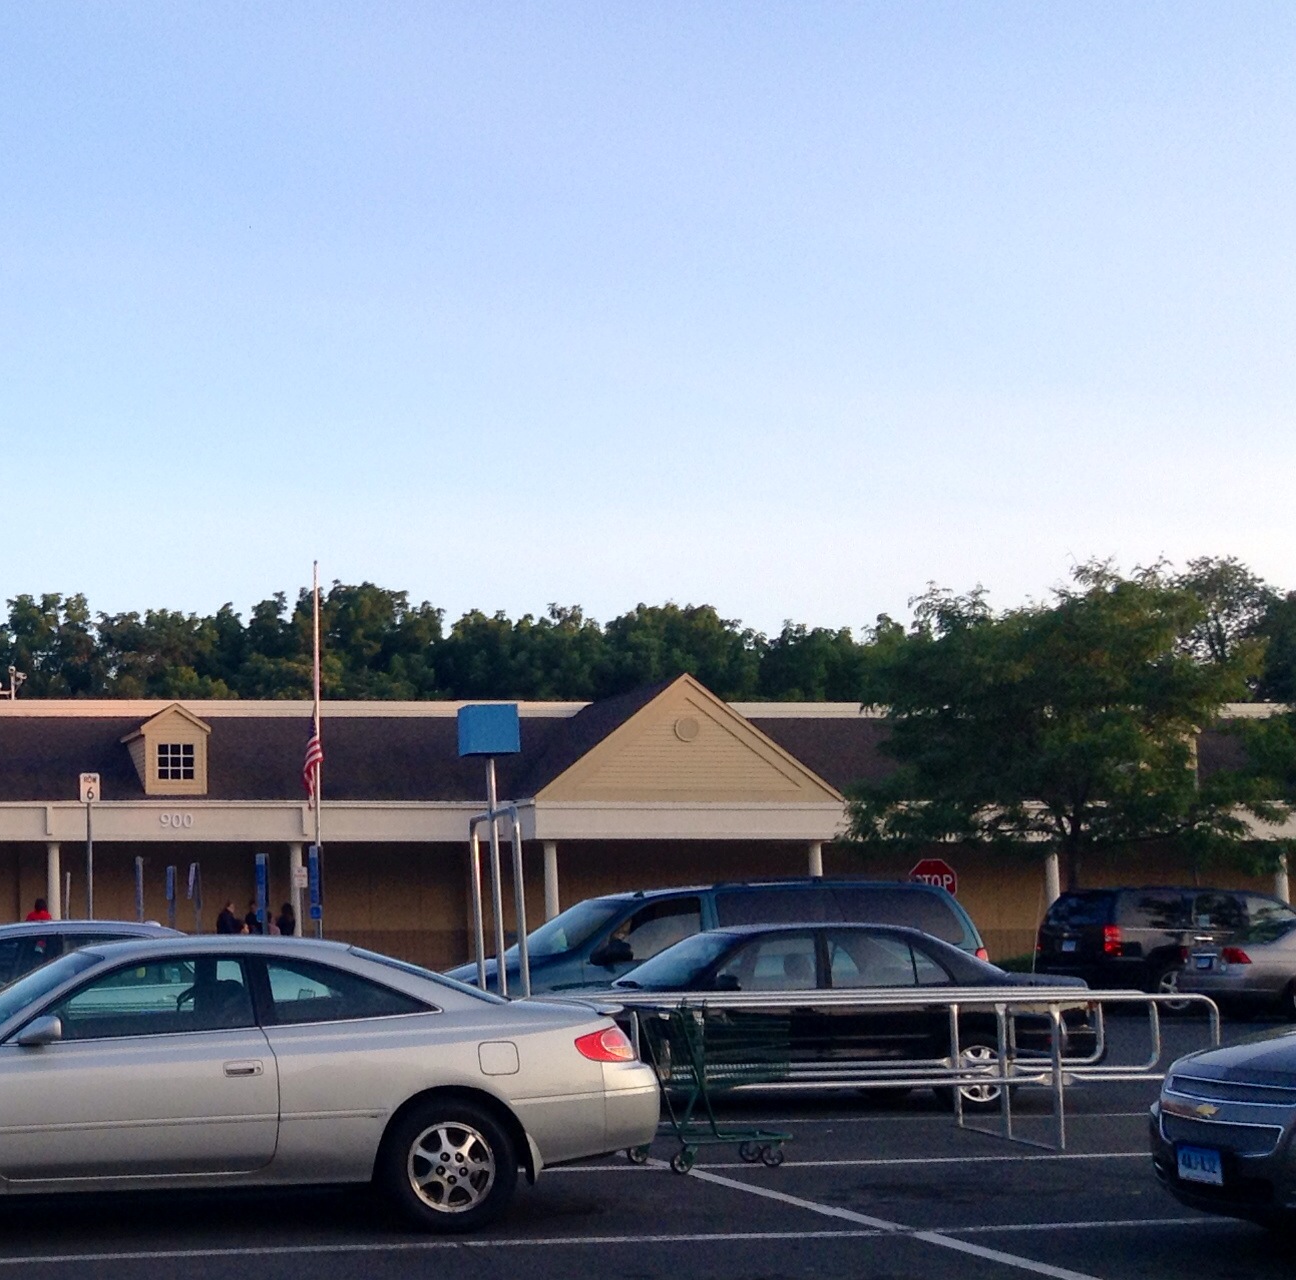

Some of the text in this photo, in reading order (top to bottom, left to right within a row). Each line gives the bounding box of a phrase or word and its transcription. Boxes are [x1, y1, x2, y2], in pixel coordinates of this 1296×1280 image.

[86, 786, 95, 800] 6
[159, 813, 194, 828] 900
[915, 873, 953, 890] TOP
